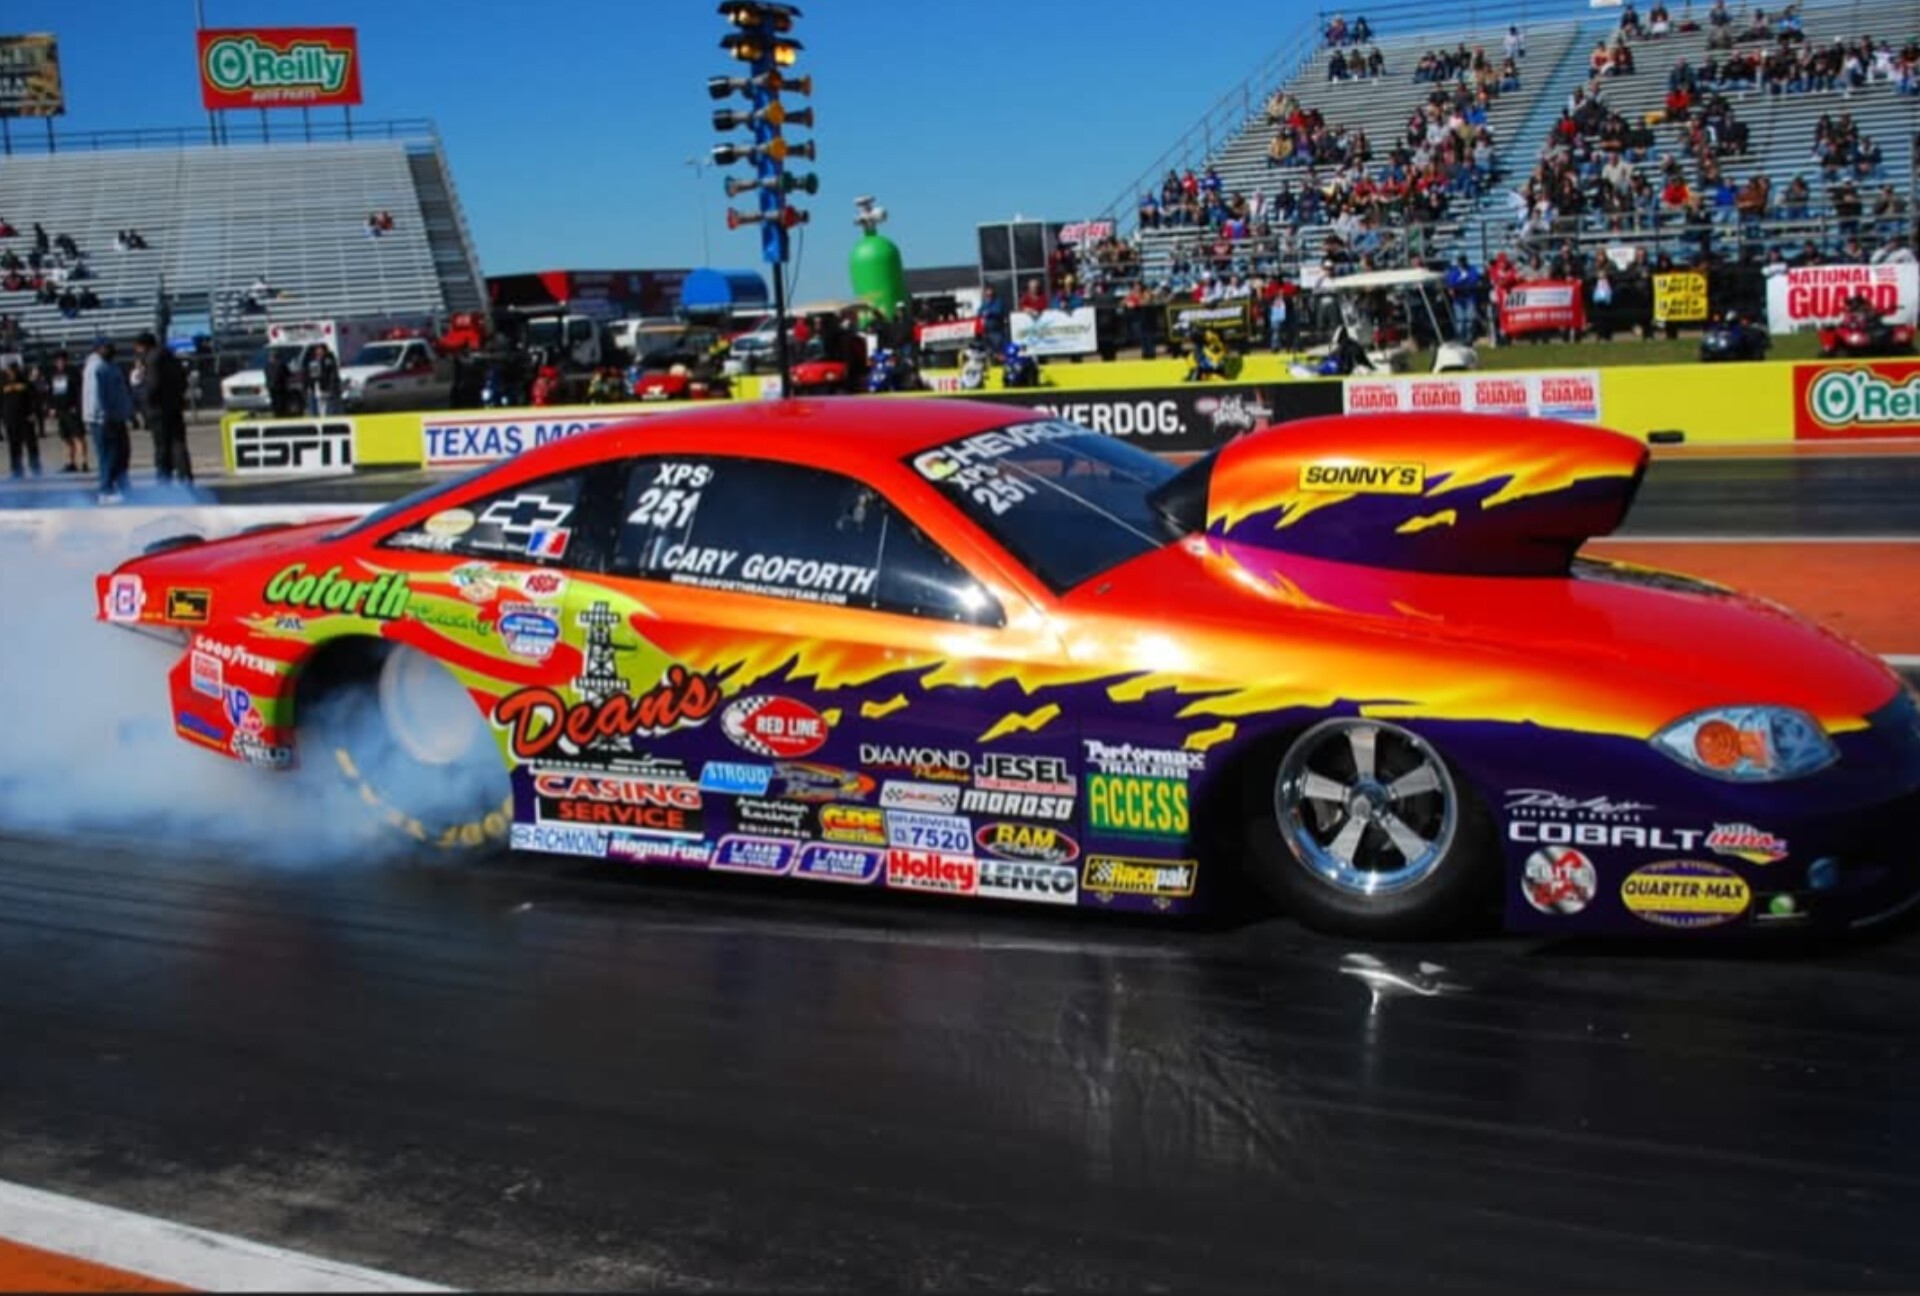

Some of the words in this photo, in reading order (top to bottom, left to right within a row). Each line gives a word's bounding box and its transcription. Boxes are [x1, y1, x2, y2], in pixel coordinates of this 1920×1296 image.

[210, 38, 346, 90] O'Reilly
[1787, 266, 1870, 285] NATIONAL
[235, 424, 352, 468] ESPN
[426, 426, 523, 457] TEXAS
[654, 463, 708, 486] XPS
[1305, 465, 1418, 486] SONNY'S
[628, 490, 702, 529] 251
[972, 472, 1038, 516] 251
[662, 544, 738, 576] CARY
[741, 553, 878, 595] GOFORTH
[264, 562, 412, 620] Goforth
[494, 664, 722, 758] Dean's
[756, 715, 784, 735] RED
[788, 717, 821, 738] LINE
[860, 744, 971, 770] DIAMOND
[975, 754, 1068, 784] JESEL
[534, 773, 702, 810] CASING
[961, 789, 1074, 820] MOROSO
[1089, 775, 1190, 834] ACCESS
[558, 800, 684, 829] SERVICE
[911, 827, 969, 851] 7520
[997, 824, 1056, 847] RAM
[1508, 821, 1704, 850] COBALT
[889, 851, 975, 890] Holley
[979, 863, 1075, 894] LENCO
[1624, 880, 1745, 899] QUARTER-MAX
